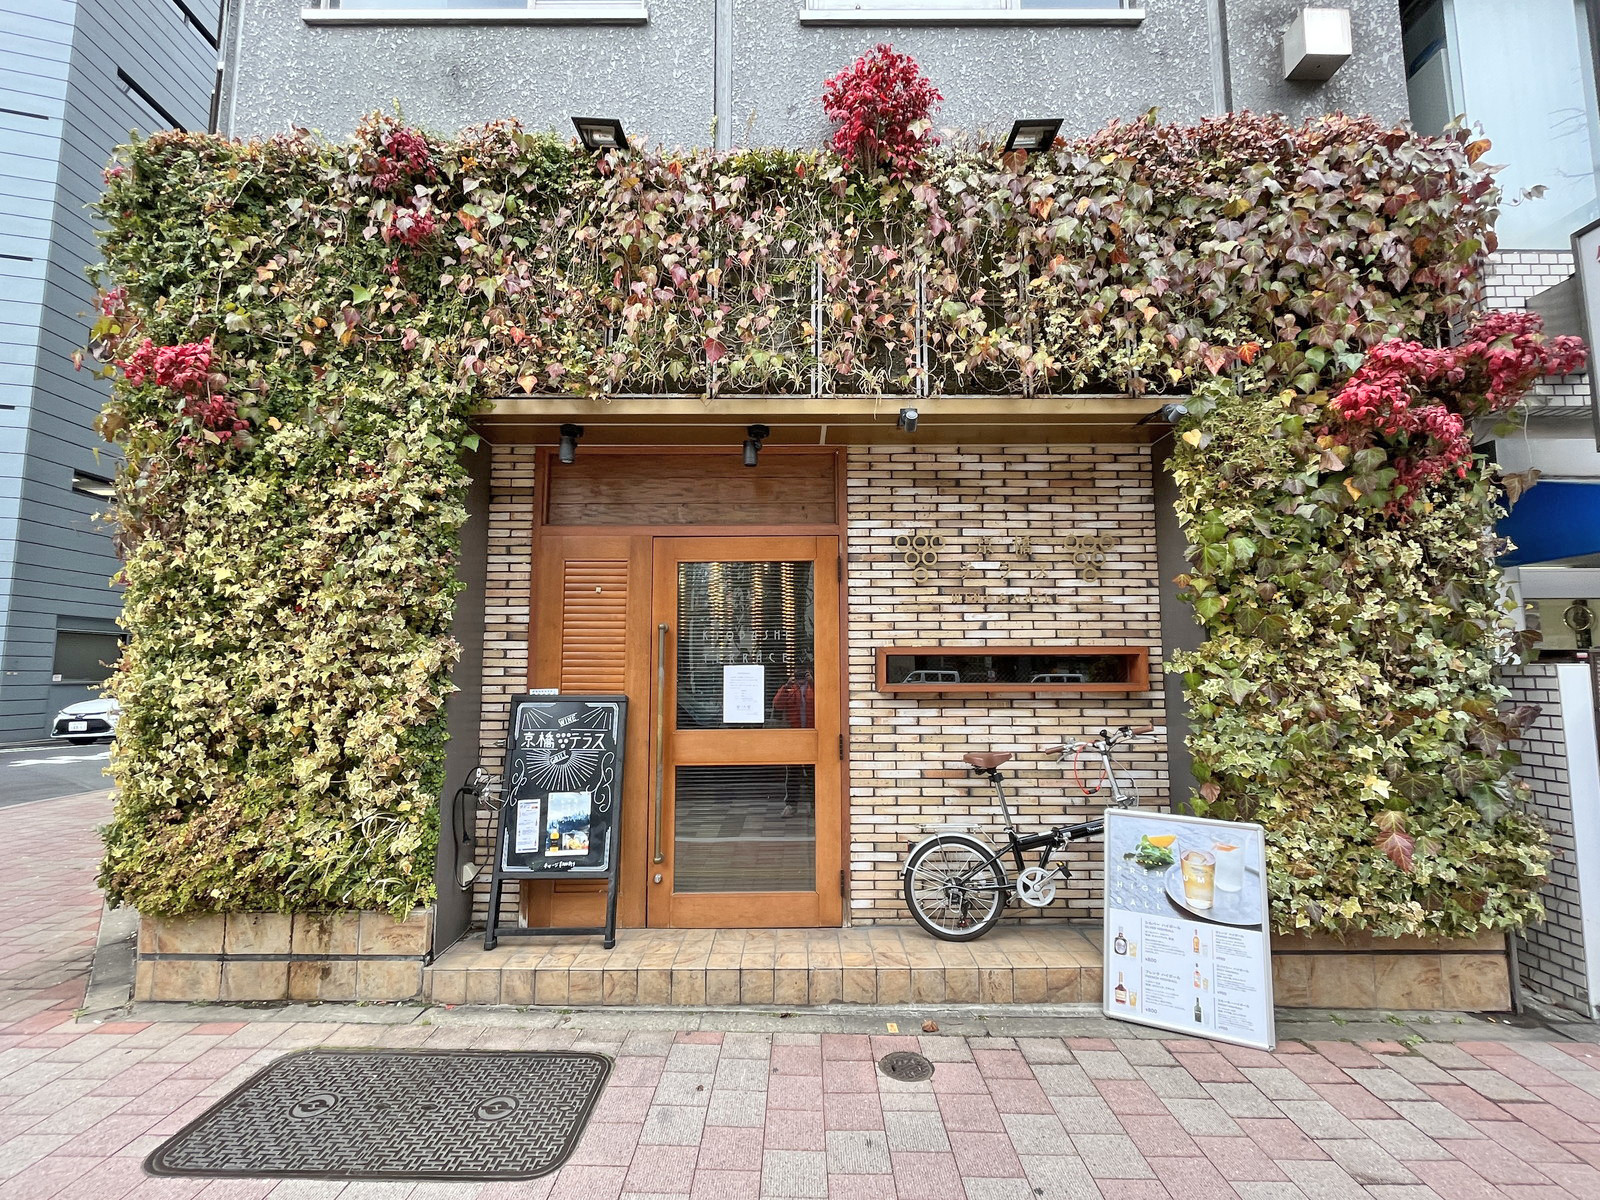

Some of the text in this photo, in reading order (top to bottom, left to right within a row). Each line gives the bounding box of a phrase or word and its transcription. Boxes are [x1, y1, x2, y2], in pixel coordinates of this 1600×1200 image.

[702, 652, 788, 665] TERRACE
[558, 713, 578, 727] WINE
[520, 731, 606, 749] 京橋 テラス
[550, 751, 569, 764] GRILL
[1116, 865, 1205, 884] PREMIUM
[1116, 881, 1163, 894] HIGH
[1116, 896, 1162, 910] BALL
